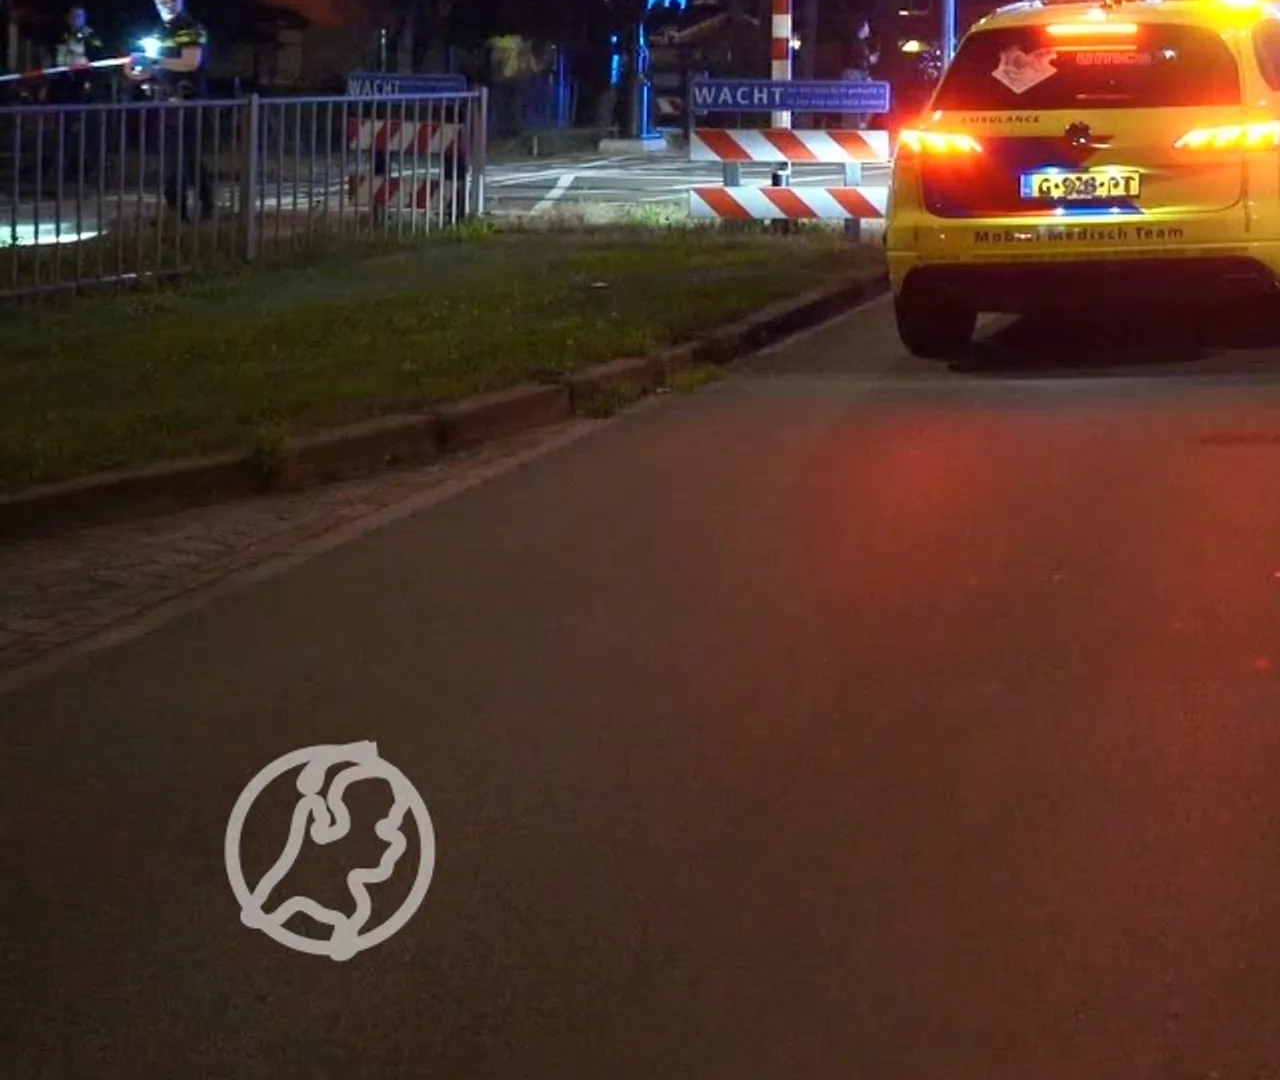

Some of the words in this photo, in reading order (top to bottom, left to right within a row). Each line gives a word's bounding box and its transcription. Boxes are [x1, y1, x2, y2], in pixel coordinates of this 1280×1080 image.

[694, 87, 785, 105] WACHT
[1048, 226, 1128, 241] Medisch
[1136, 226, 1184, 240] Team
